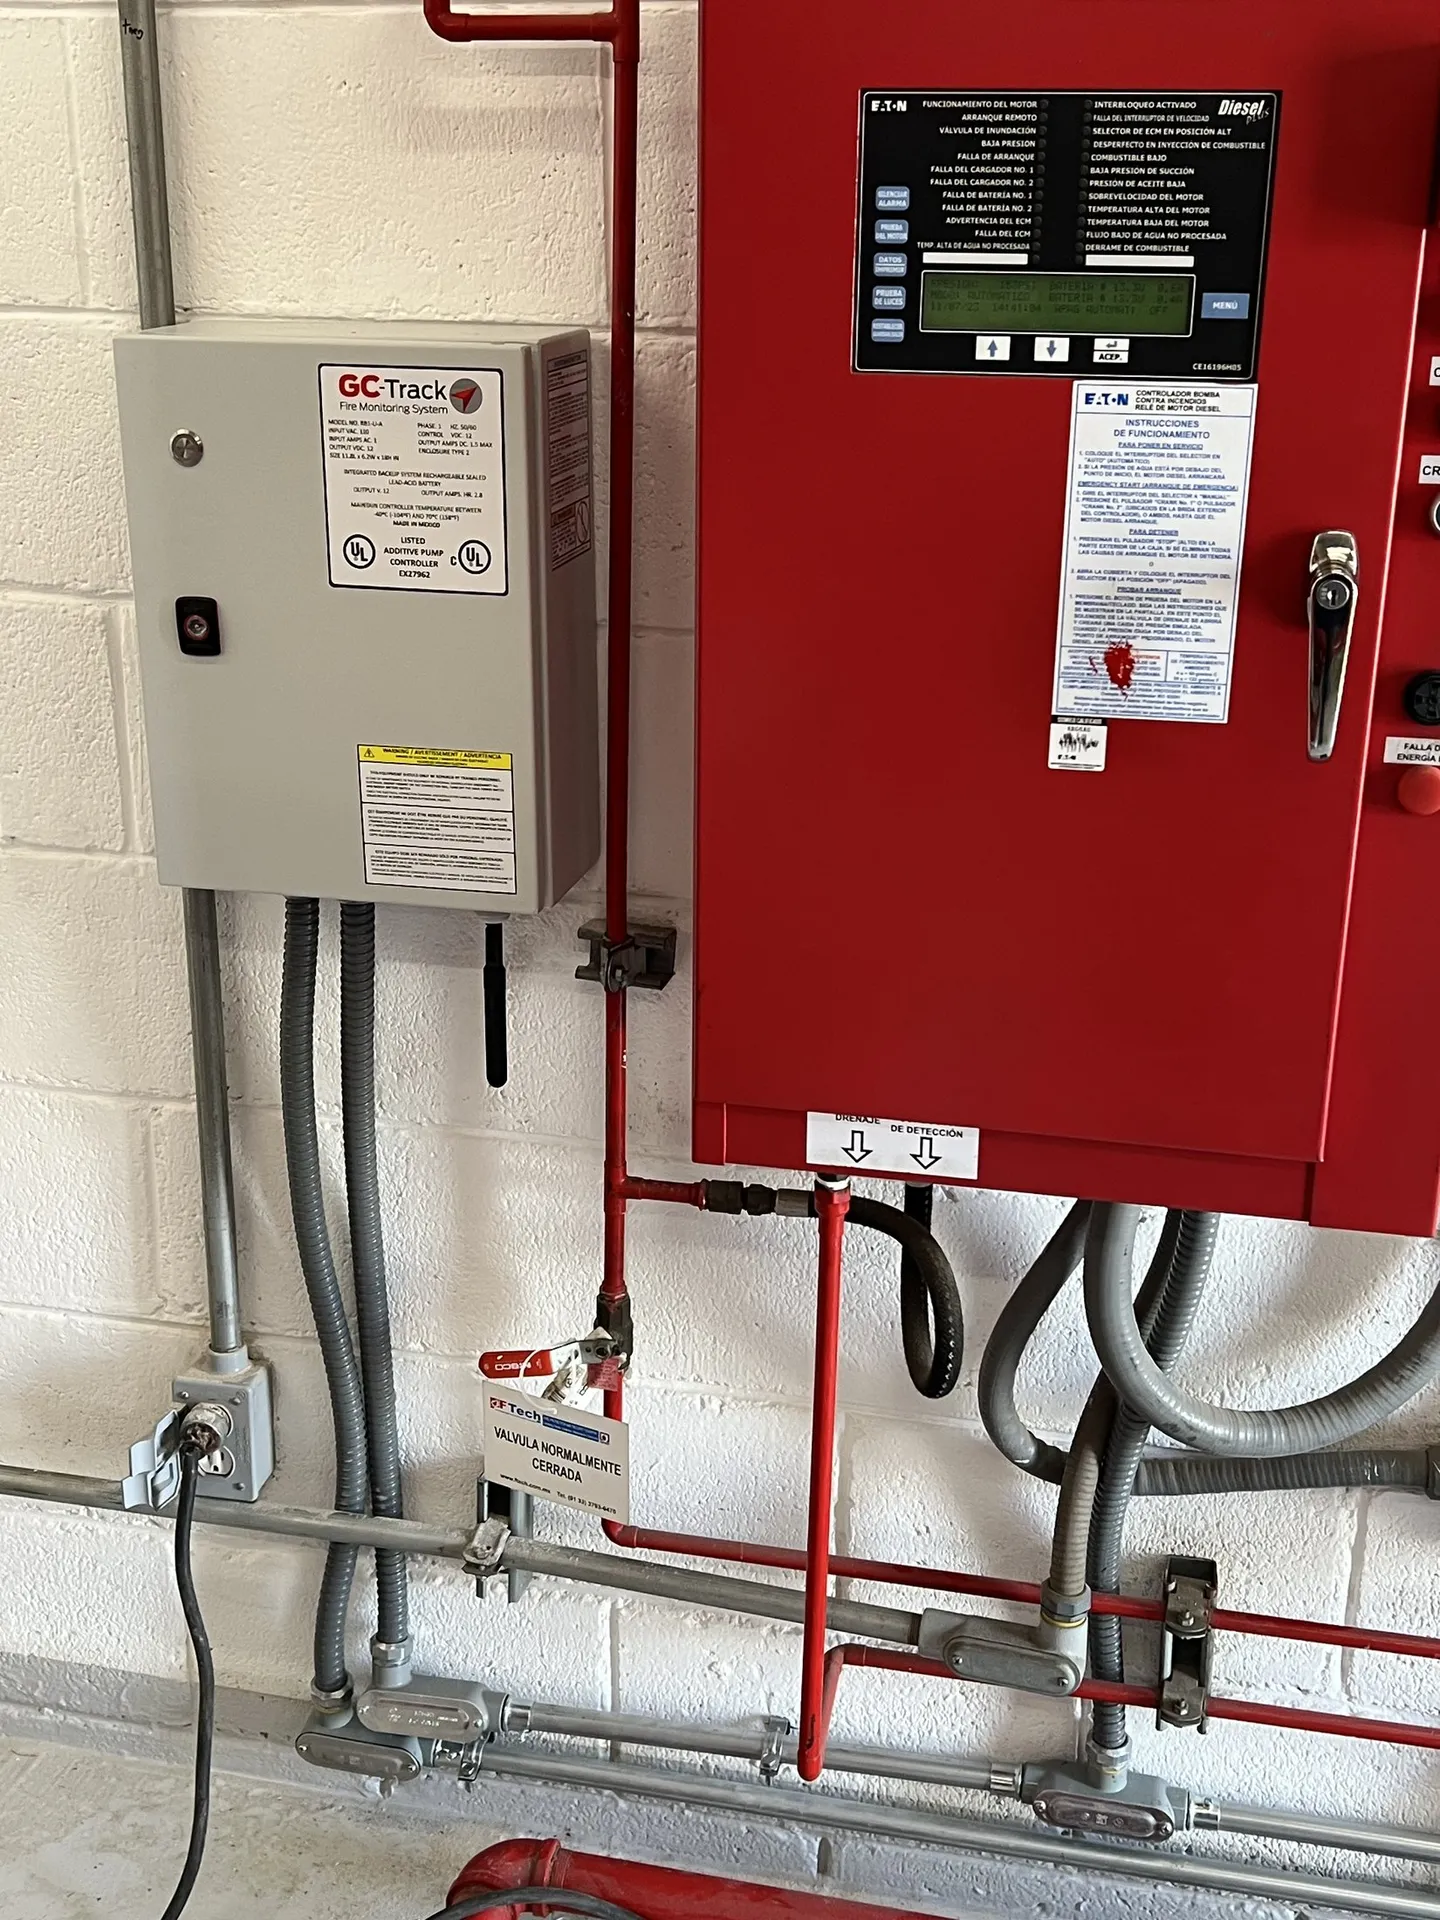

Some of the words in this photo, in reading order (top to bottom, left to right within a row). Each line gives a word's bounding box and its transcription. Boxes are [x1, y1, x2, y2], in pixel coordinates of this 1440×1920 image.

[1094, 101, 1155, 110] INTERBLOQUEO
[1218, 100, 1265, 115] Diesel
[962, 114, 1003, 122] ARRANQUE
[994, 153, 1034, 162] ARRANQUE
[339, 374, 447, 400] GC-Track
[1136, 397, 1166, 407] CONTRA
[340, 401, 357, 411] Fire
[359, 402, 410, 415] Monitoring
[412, 404, 448, 416] System
[1156, 403, 1165, 411] DE
[1167, 403, 1194, 412] MOTOR
[1195, 404, 1220, 412] DIESEL
[1126, 419, 1199, 428] INSTRUCCIONES
[1128, 429, 1210, 439] FUNCIONAMIENTO
[401, 536, 426, 545] LISTED
[350, 542, 368, 561] UL
[384, 547, 419, 556] ADDITIVE
[421, 549, 444, 557] PUMP
[466, 547, 483, 567] UL
[390, 558, 438, 568] CONTROLLER
[399, 570, 430, 578] EX27962
[835, 1114, 881, 1124] DRENAJE
[891, 1124, 903, 1133] DE
[494, 1426, 539, 1451] VALVULA
[541, 1441, 621, 1477] NORMALMENTE
[532, 1457, 582, 1484] CERRADA
